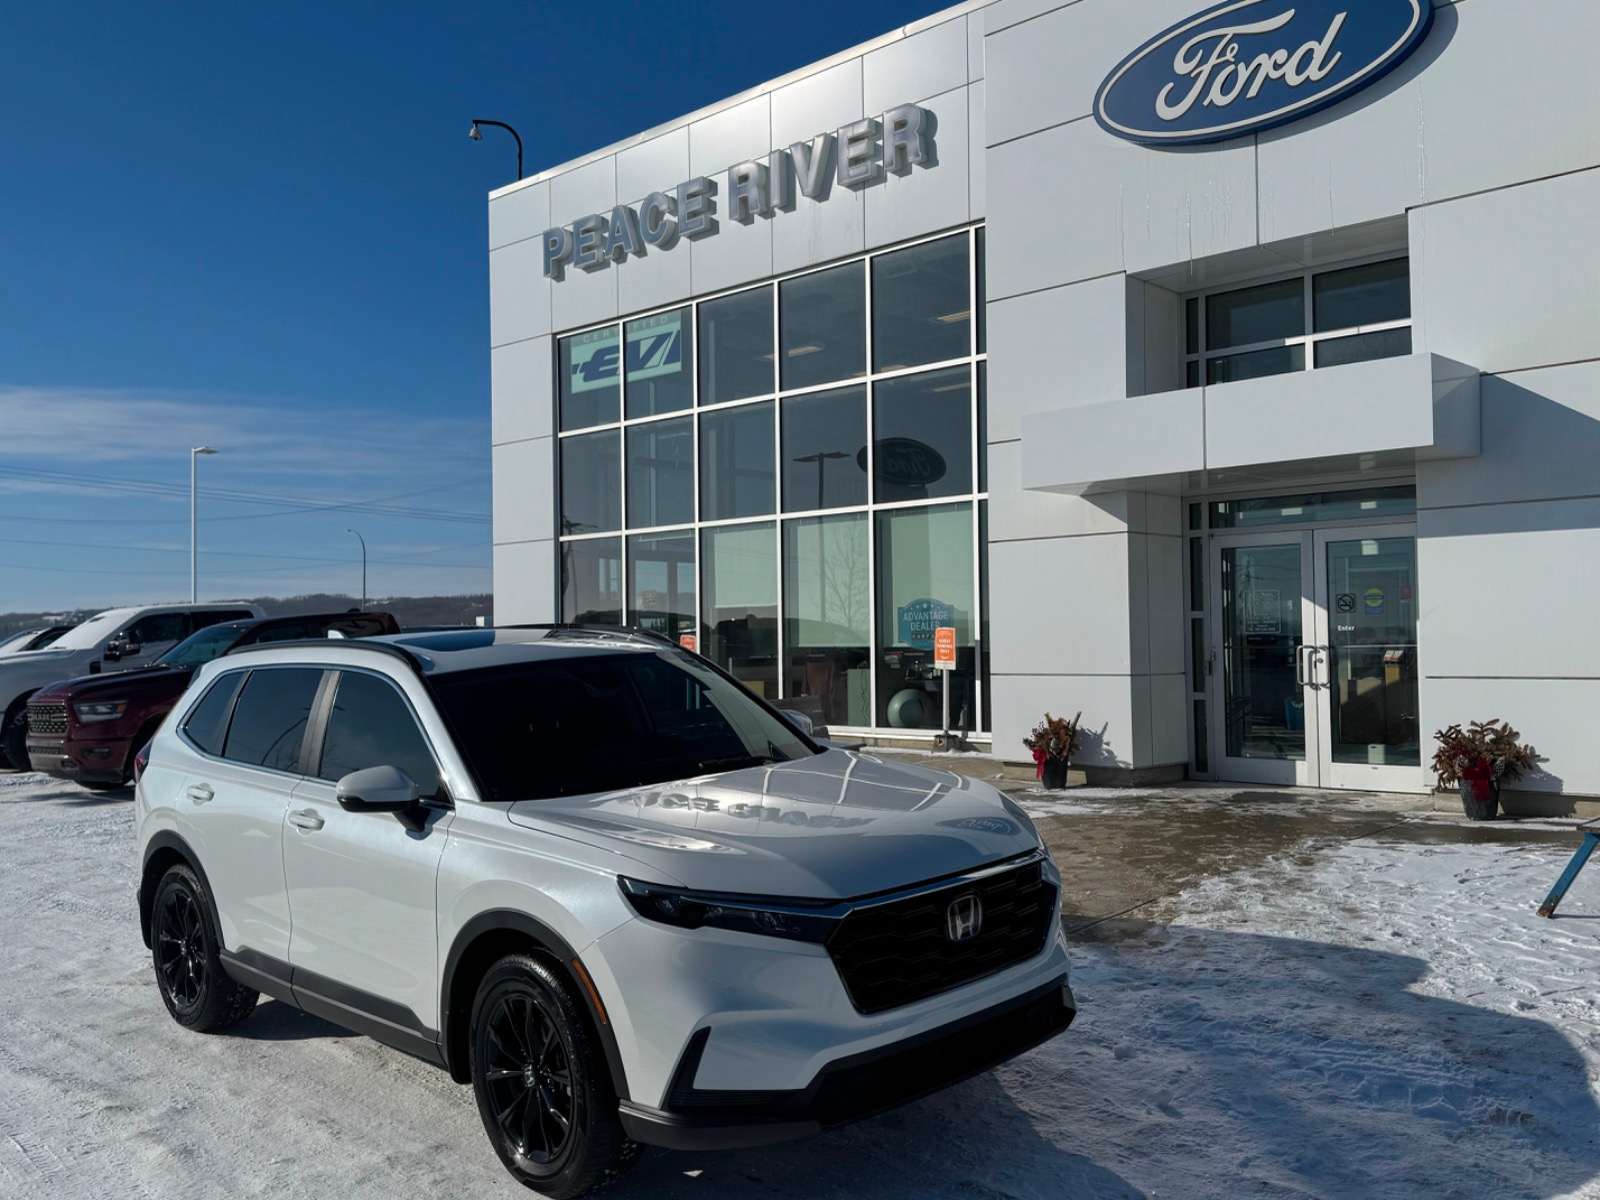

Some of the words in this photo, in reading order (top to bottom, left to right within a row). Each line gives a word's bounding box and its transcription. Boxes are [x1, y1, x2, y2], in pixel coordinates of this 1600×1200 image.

[1155, 8, 1347, 121] Ford
[543, 176, 719, 281] PEACE
[728, 103, 937, 225] RIVER
[903, 610, 949, 621] ADVANTAGE
[1337, 624, 1355, 632] Enter
